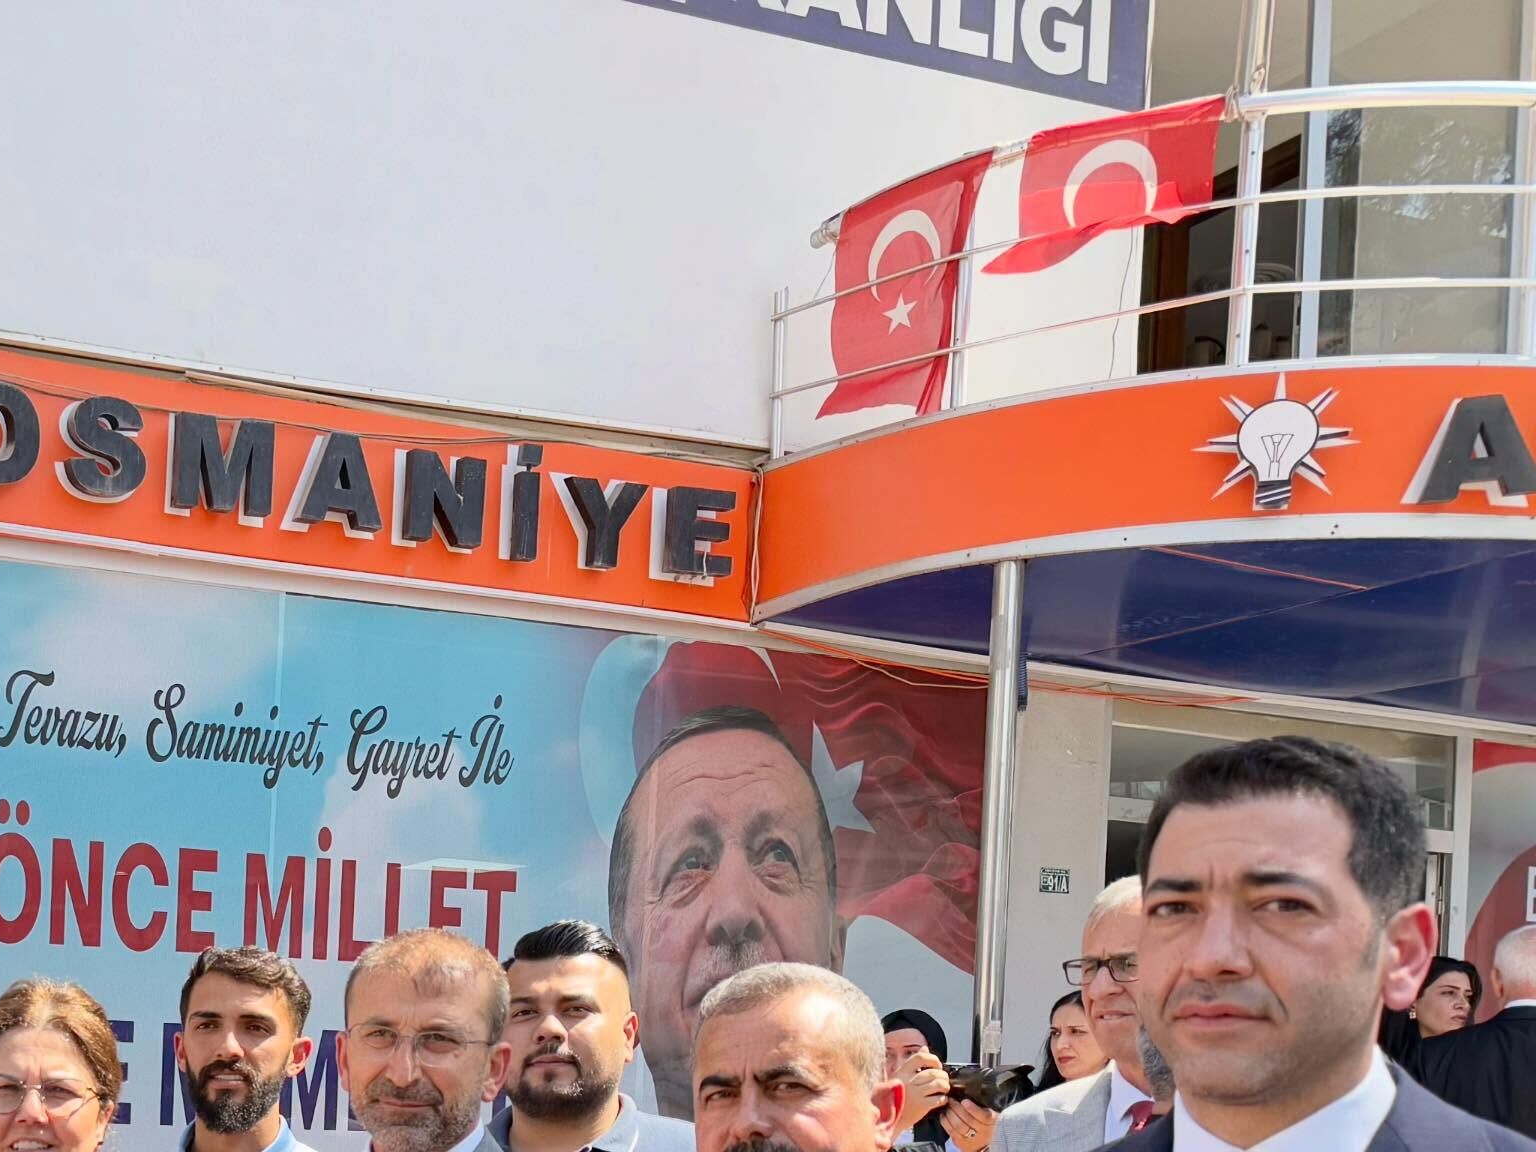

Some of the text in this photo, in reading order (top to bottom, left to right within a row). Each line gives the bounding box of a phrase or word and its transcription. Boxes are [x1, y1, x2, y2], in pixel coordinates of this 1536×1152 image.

[146, 683, 328, 789] Samimiyet,
[347, 705, 462, 799] Gayret
[459, 694, 515, 787] İle
[242, 826, 517, 965] MİLLET
